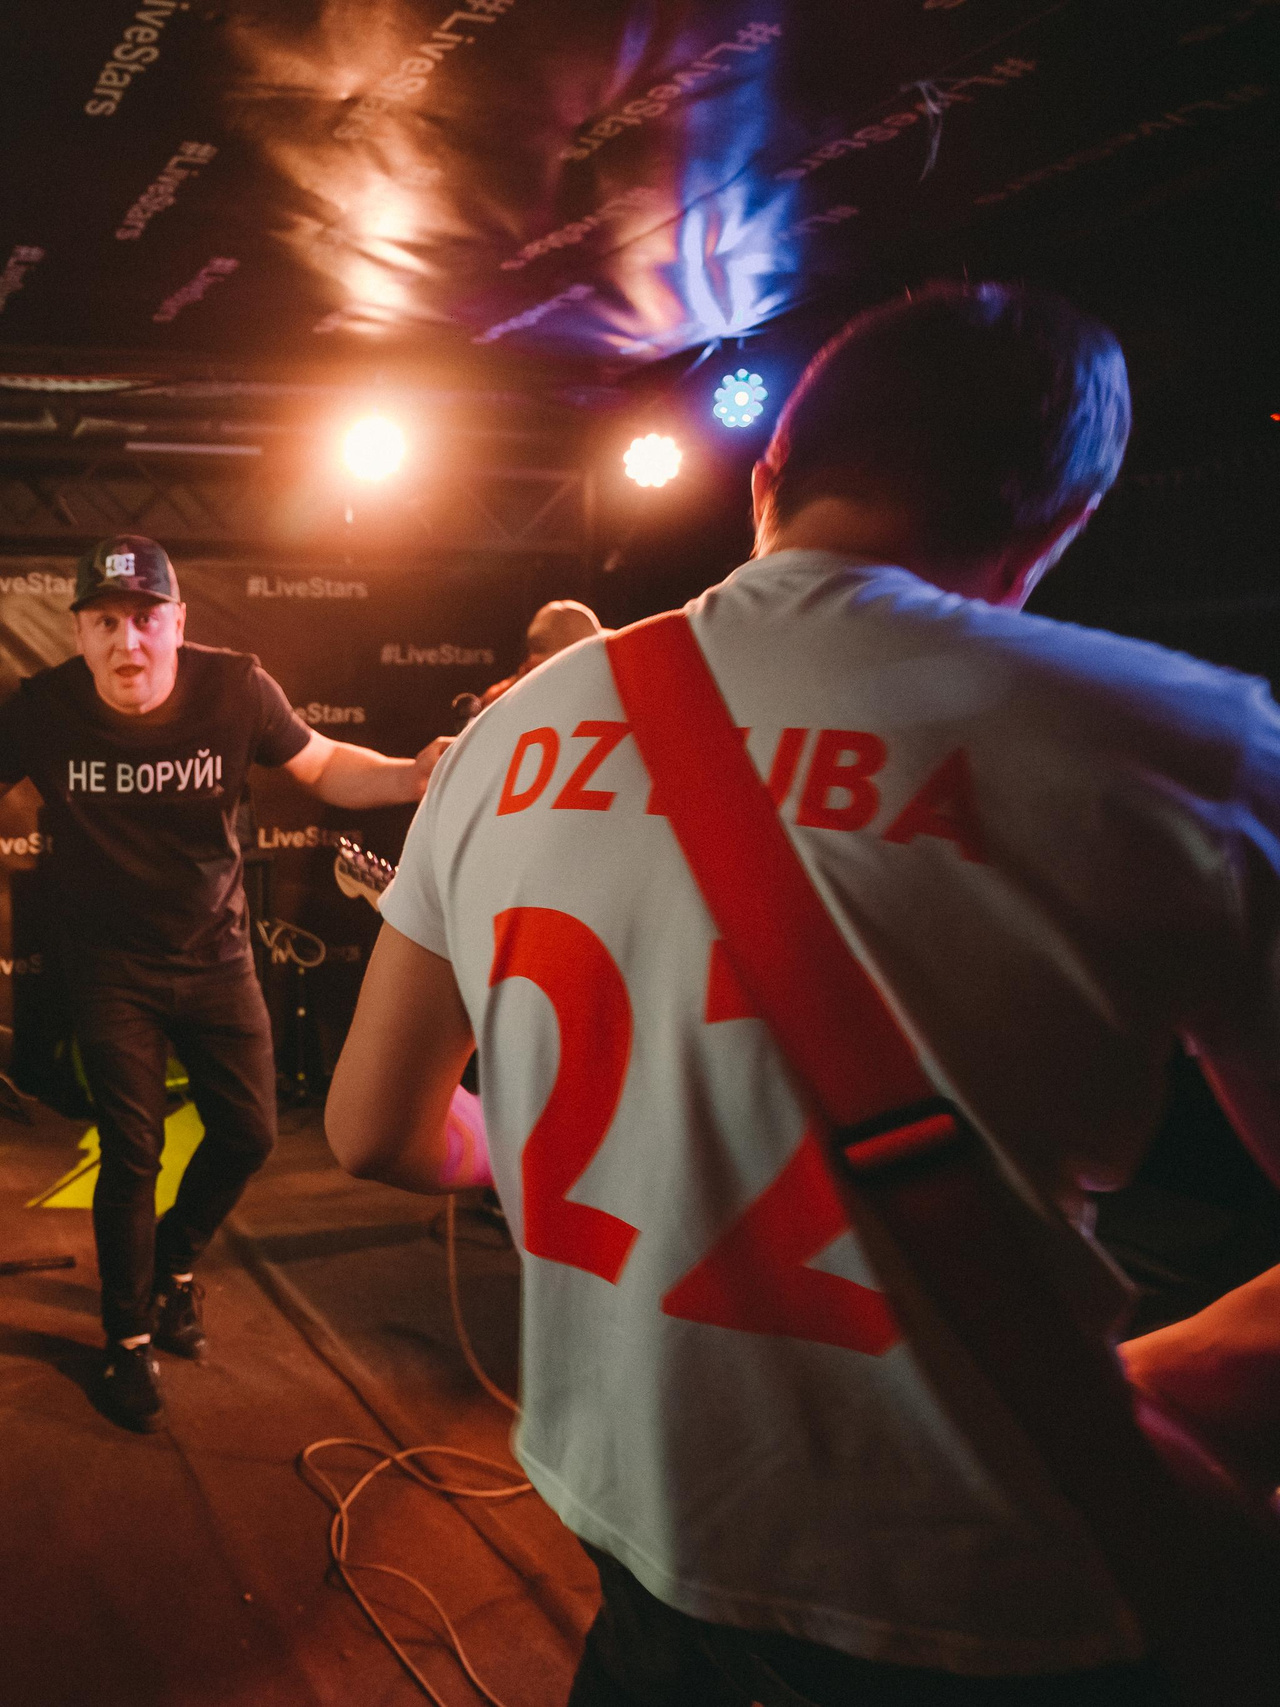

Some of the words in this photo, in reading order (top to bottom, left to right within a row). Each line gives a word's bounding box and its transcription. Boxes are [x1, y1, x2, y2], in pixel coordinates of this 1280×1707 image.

[246, 577, 368, 599] #LiveStars
[380, 644, 494, 666] #LiveStars
[69, 760, 107, 792] НЕ
[117, 748, 222, 794] ВОРУЙ!
[496, 720, 994, 867] DZUBA
